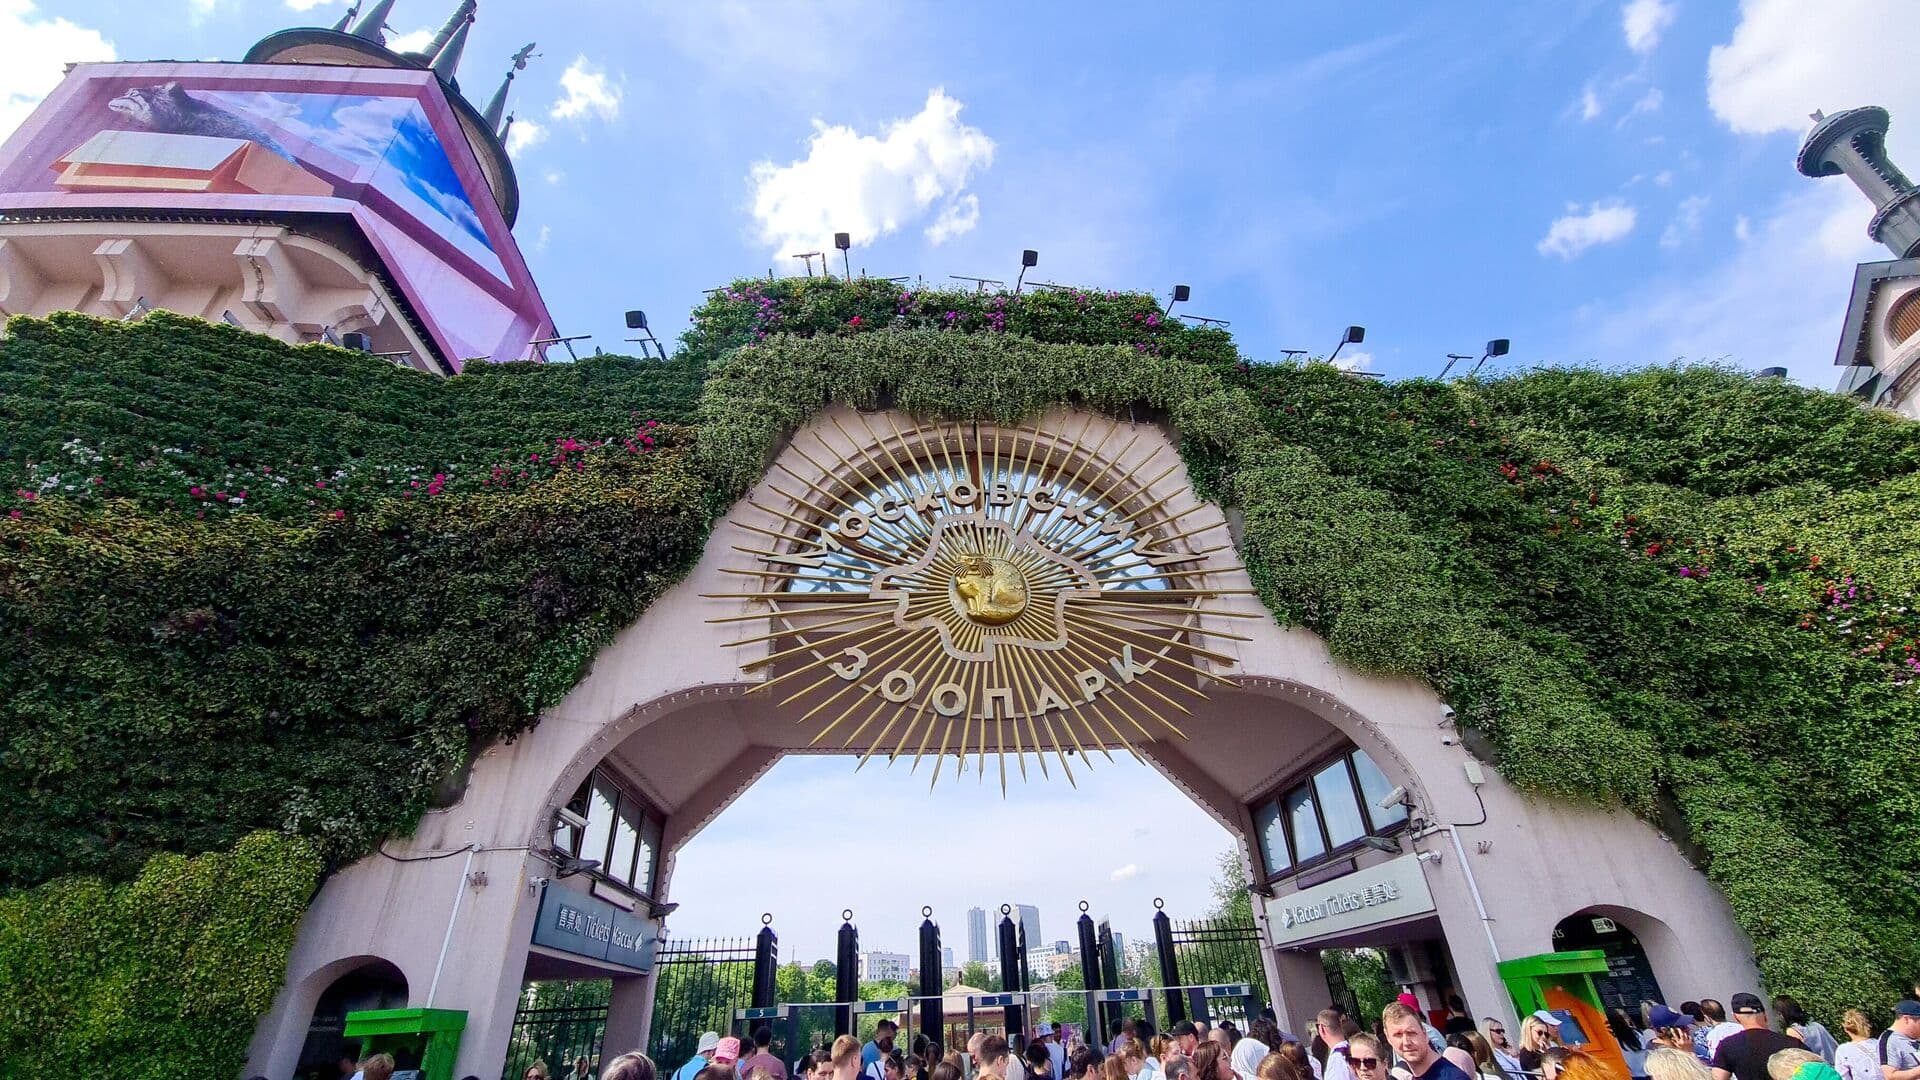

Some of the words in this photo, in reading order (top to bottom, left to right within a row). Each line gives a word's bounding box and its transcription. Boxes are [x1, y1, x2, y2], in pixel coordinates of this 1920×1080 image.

[758, 479, 1209, 567] МОСКОВСКИЙ
[833, 645, 1150, 719] ЗООПАРК
[585, 915, 610, 942] Tickets
[611, 925, 634, 950] Кассы
[1293, 905, 1322, 925] Кассы
[1323, 893, 1360, 916] Tickets
